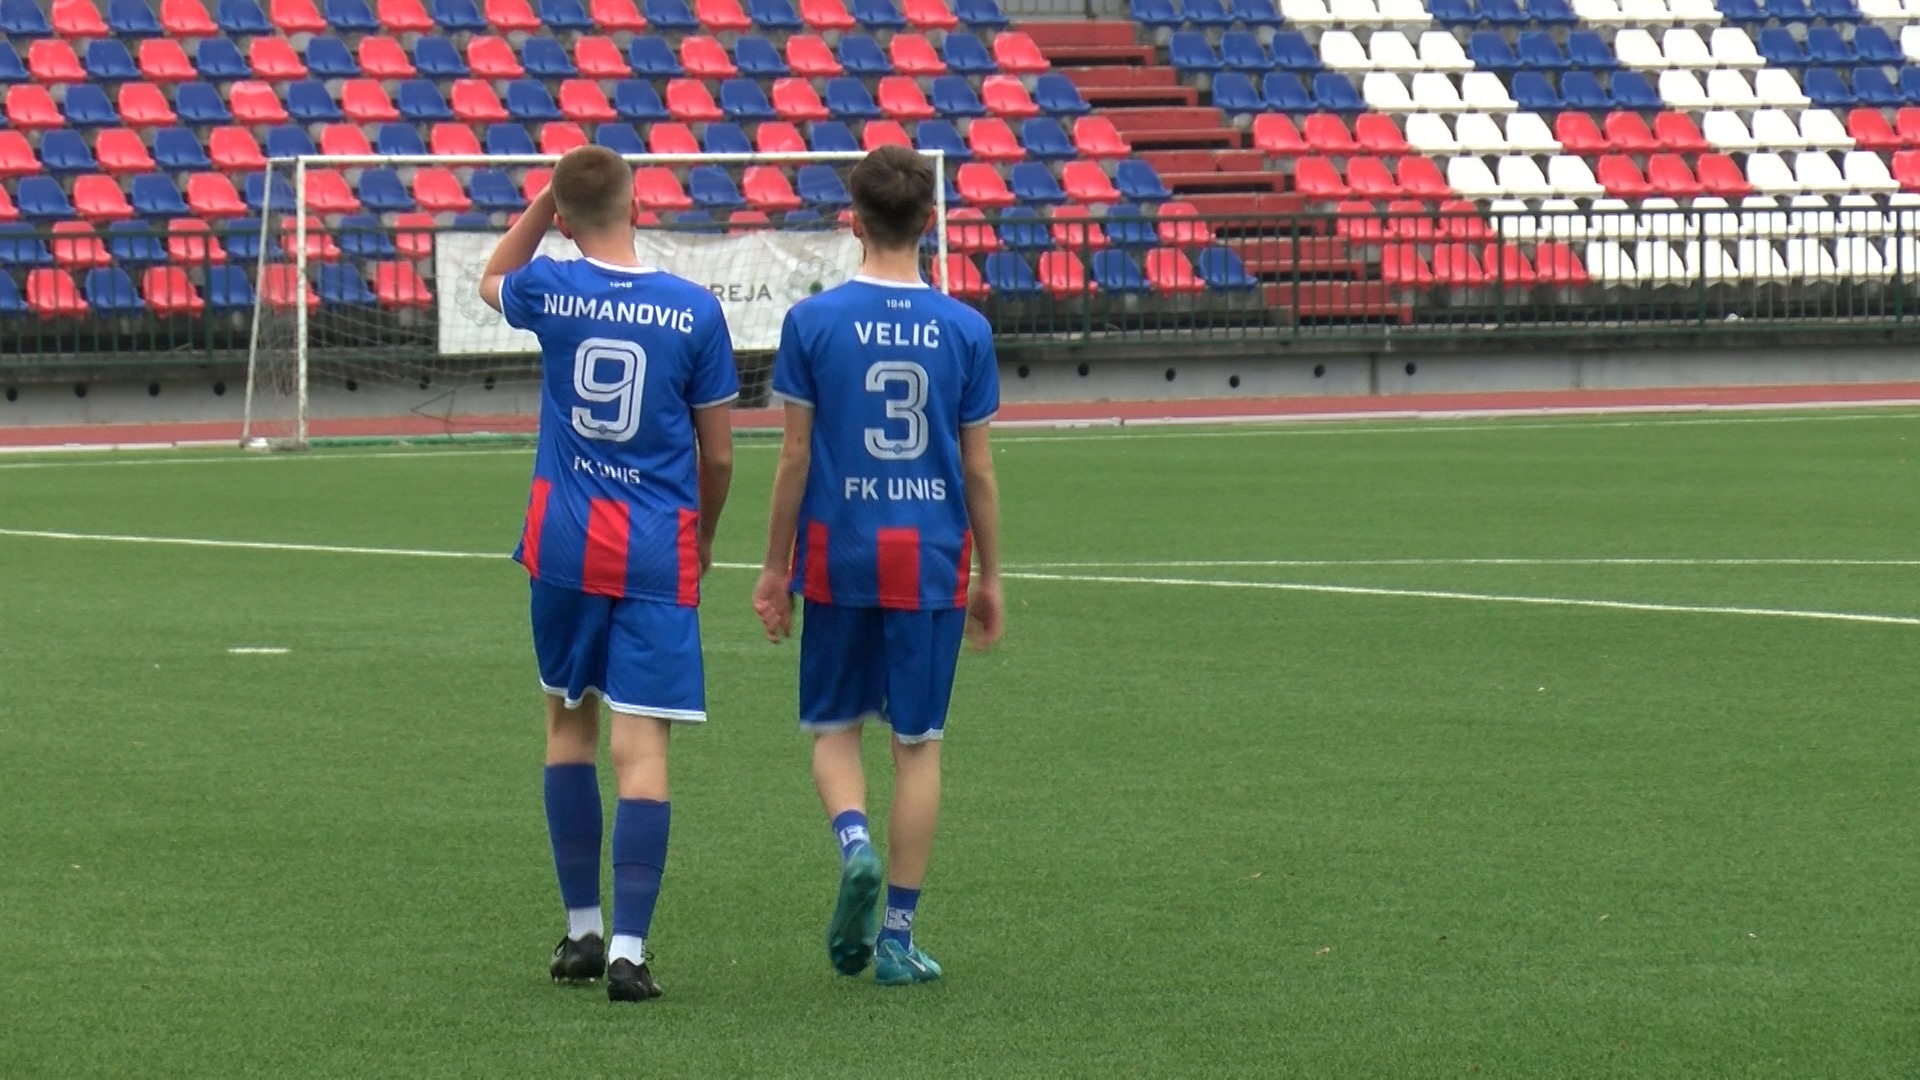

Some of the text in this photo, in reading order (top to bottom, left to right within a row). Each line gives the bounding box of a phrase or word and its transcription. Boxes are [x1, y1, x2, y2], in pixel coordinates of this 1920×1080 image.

[705, 283, 773, 302] REJA
[543, 293, 694, 334] NUMANOVIĆ
[854, 319, 940, 349] VELIĆ
[571, 337, 647, 442] 9
[864, 361, 929, 460] 3
[596, 461, 640, 484] UNIS
[844, 477, 947, 500] FK UNIS
